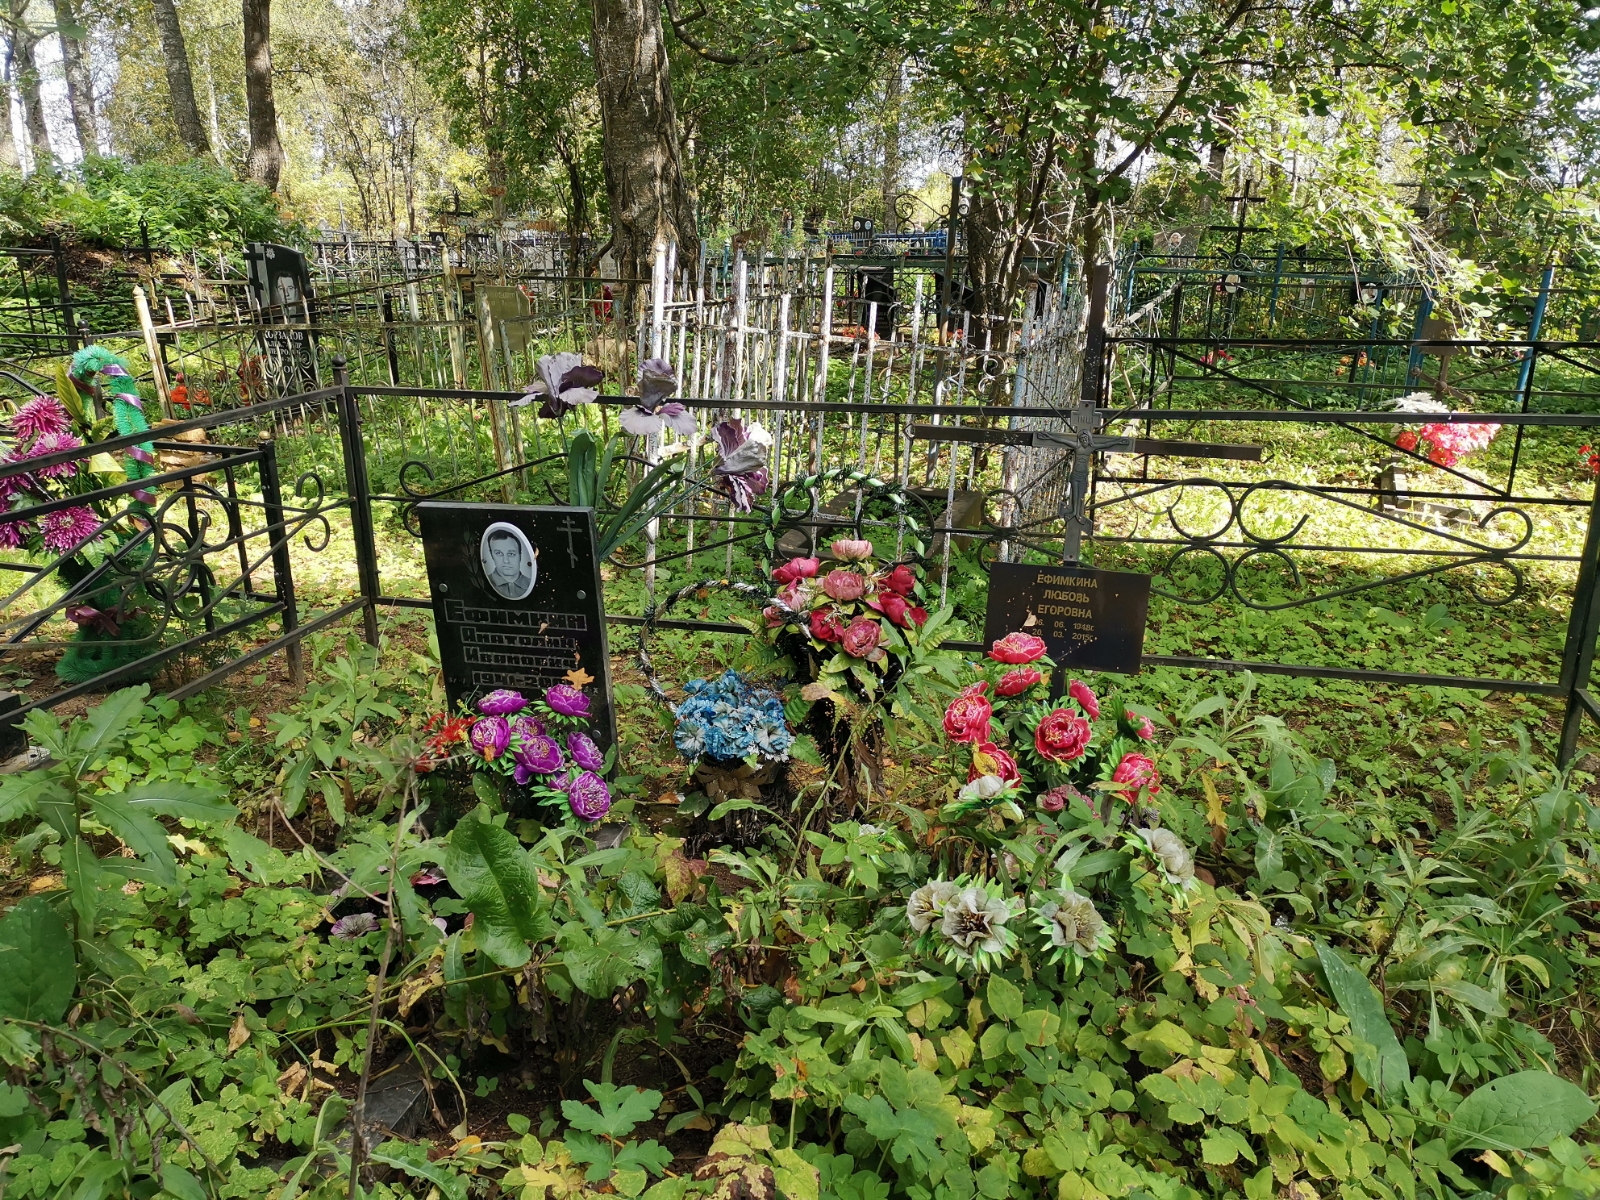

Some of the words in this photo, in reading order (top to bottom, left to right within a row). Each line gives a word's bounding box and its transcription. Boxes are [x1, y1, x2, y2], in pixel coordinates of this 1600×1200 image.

[1036, 573, 1098, 589] ЕФИМКИНА
[1042, 589, 1090, 604] ЛЮБОВЬ
[1037, 604, 1093, 619] ЕГОРОВНА
